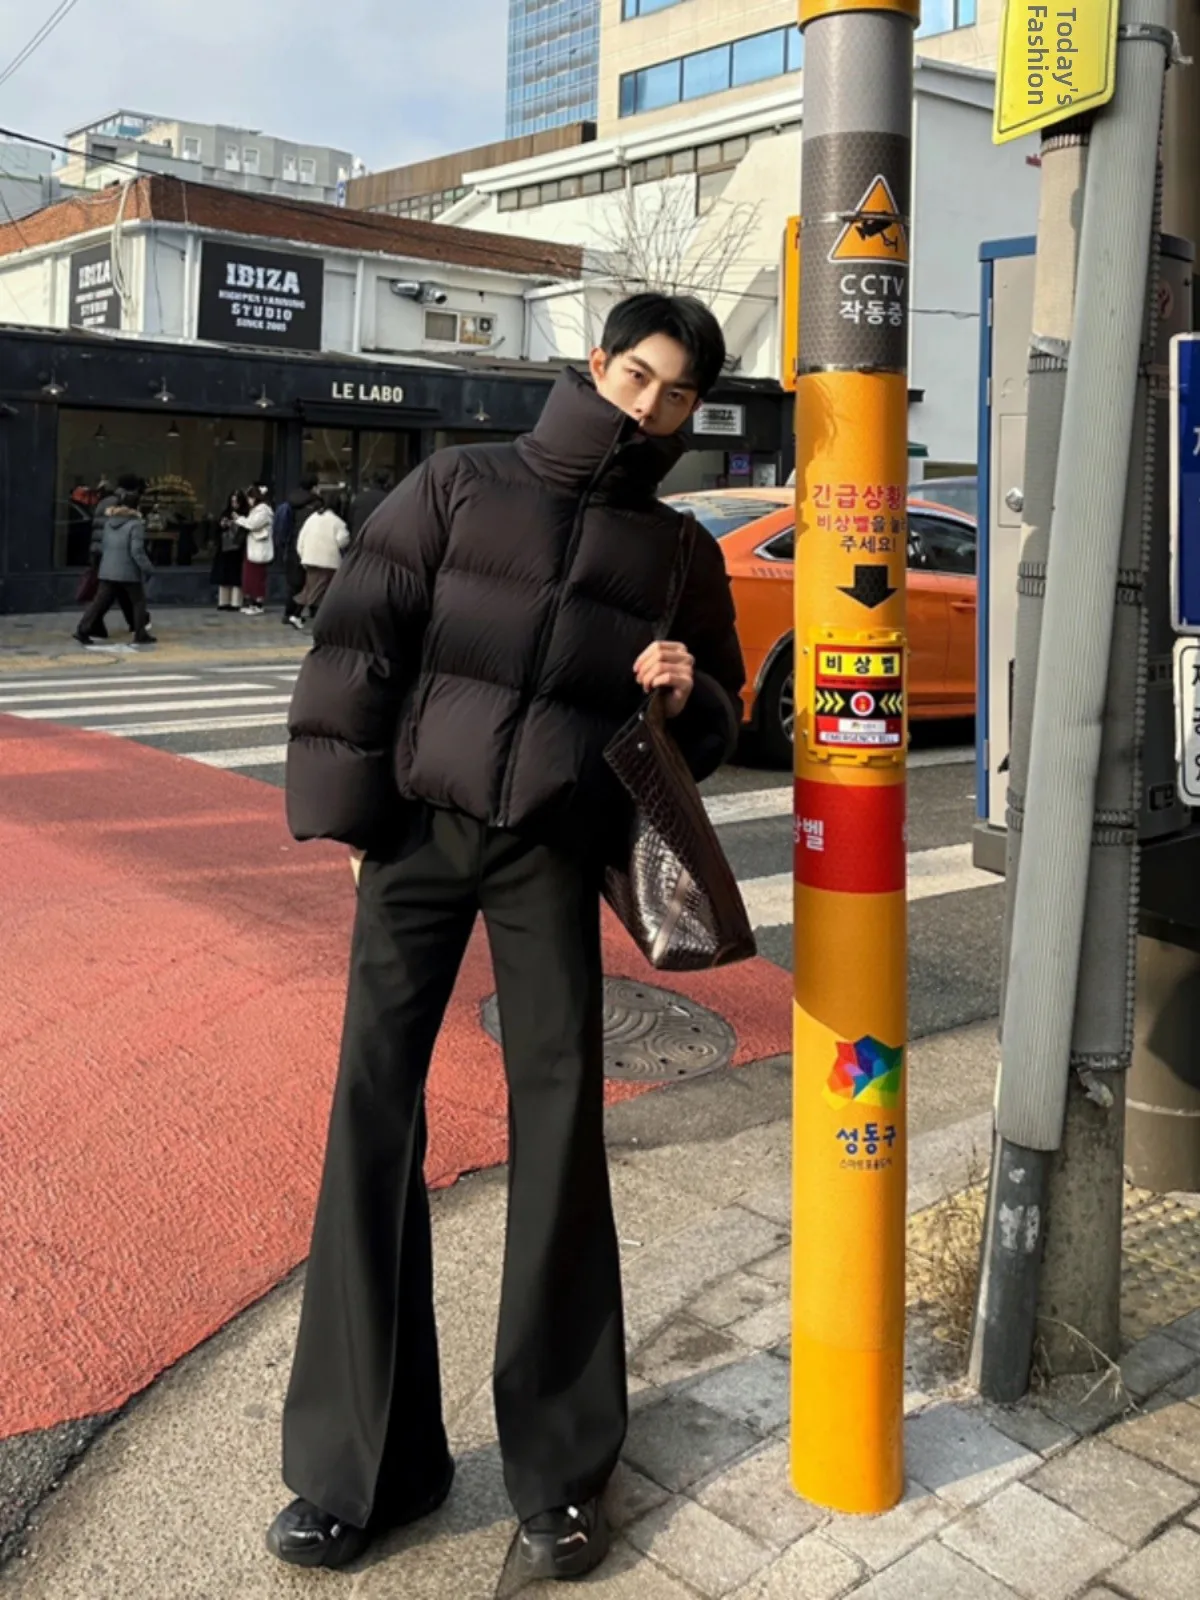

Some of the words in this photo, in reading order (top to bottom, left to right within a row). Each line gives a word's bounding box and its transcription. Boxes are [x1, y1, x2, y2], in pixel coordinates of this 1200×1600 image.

[79, 260, 110, 289] IBIZA
[226, 263, 300, 294] IBIZA
[840, 274, 905, 296] CCTV
[231, 302, 293, 321] STUDIO
[332, 381, 354, 400] LE
[359, 384, 404, 404] LABO
[840, 535, 897, 554] 주세요!
[836, 1122, 897, 1155] 성동구
